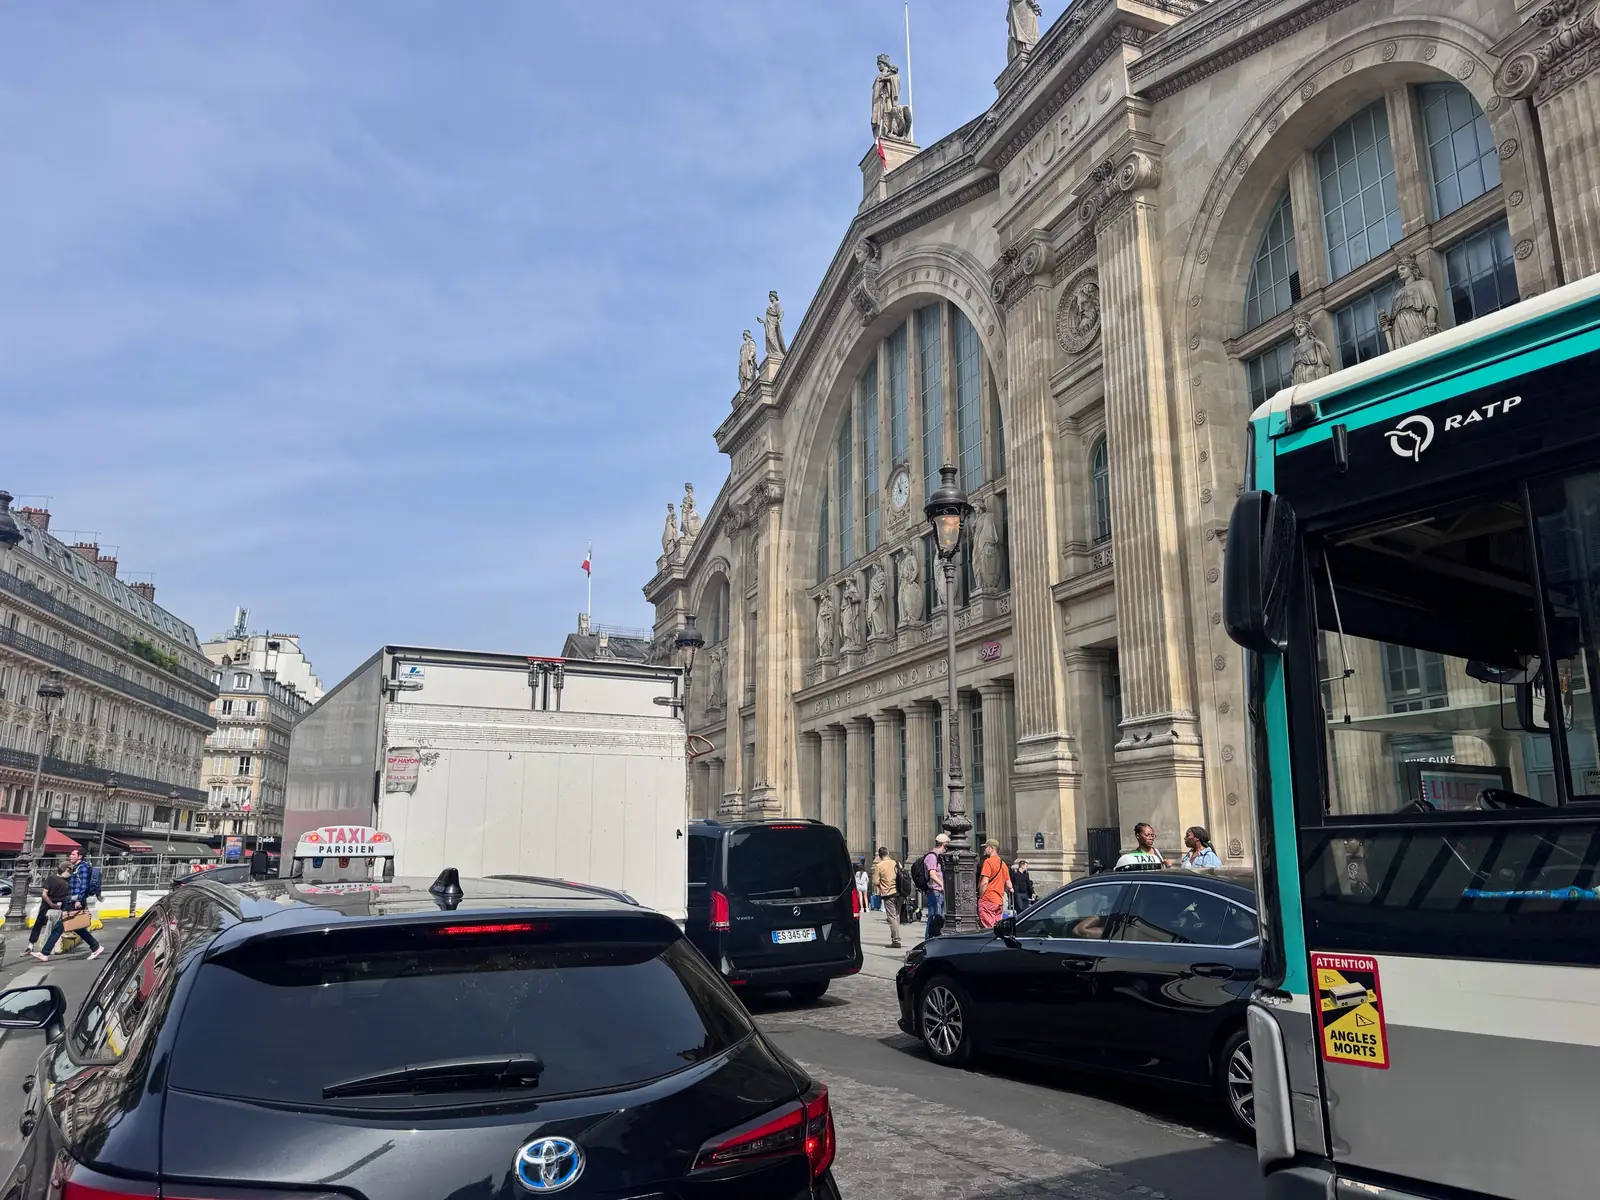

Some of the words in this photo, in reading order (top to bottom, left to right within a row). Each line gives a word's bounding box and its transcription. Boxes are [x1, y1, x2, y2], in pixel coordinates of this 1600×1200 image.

[1021, 97, 1092, 188] NORD
[1444, 396, 1522, 431] RATP
[814, 691, 851, 714] GARE
[864, 679, 883, 699] DU
[895, 658, 949, 688] NORD
[1428, 755, 1456, 764] GUYS
[324, 828, 366, 843] TAXI
[319, 845, 374, 853] PARISIEN
[1134, 855, 1156, 863] TAXI
[1316, 957, 1374, 970] ATTENTION
[1330, 1029, 1377, 1045] ANGLES
[1334, 1042, 1377, 1057] MORTS
